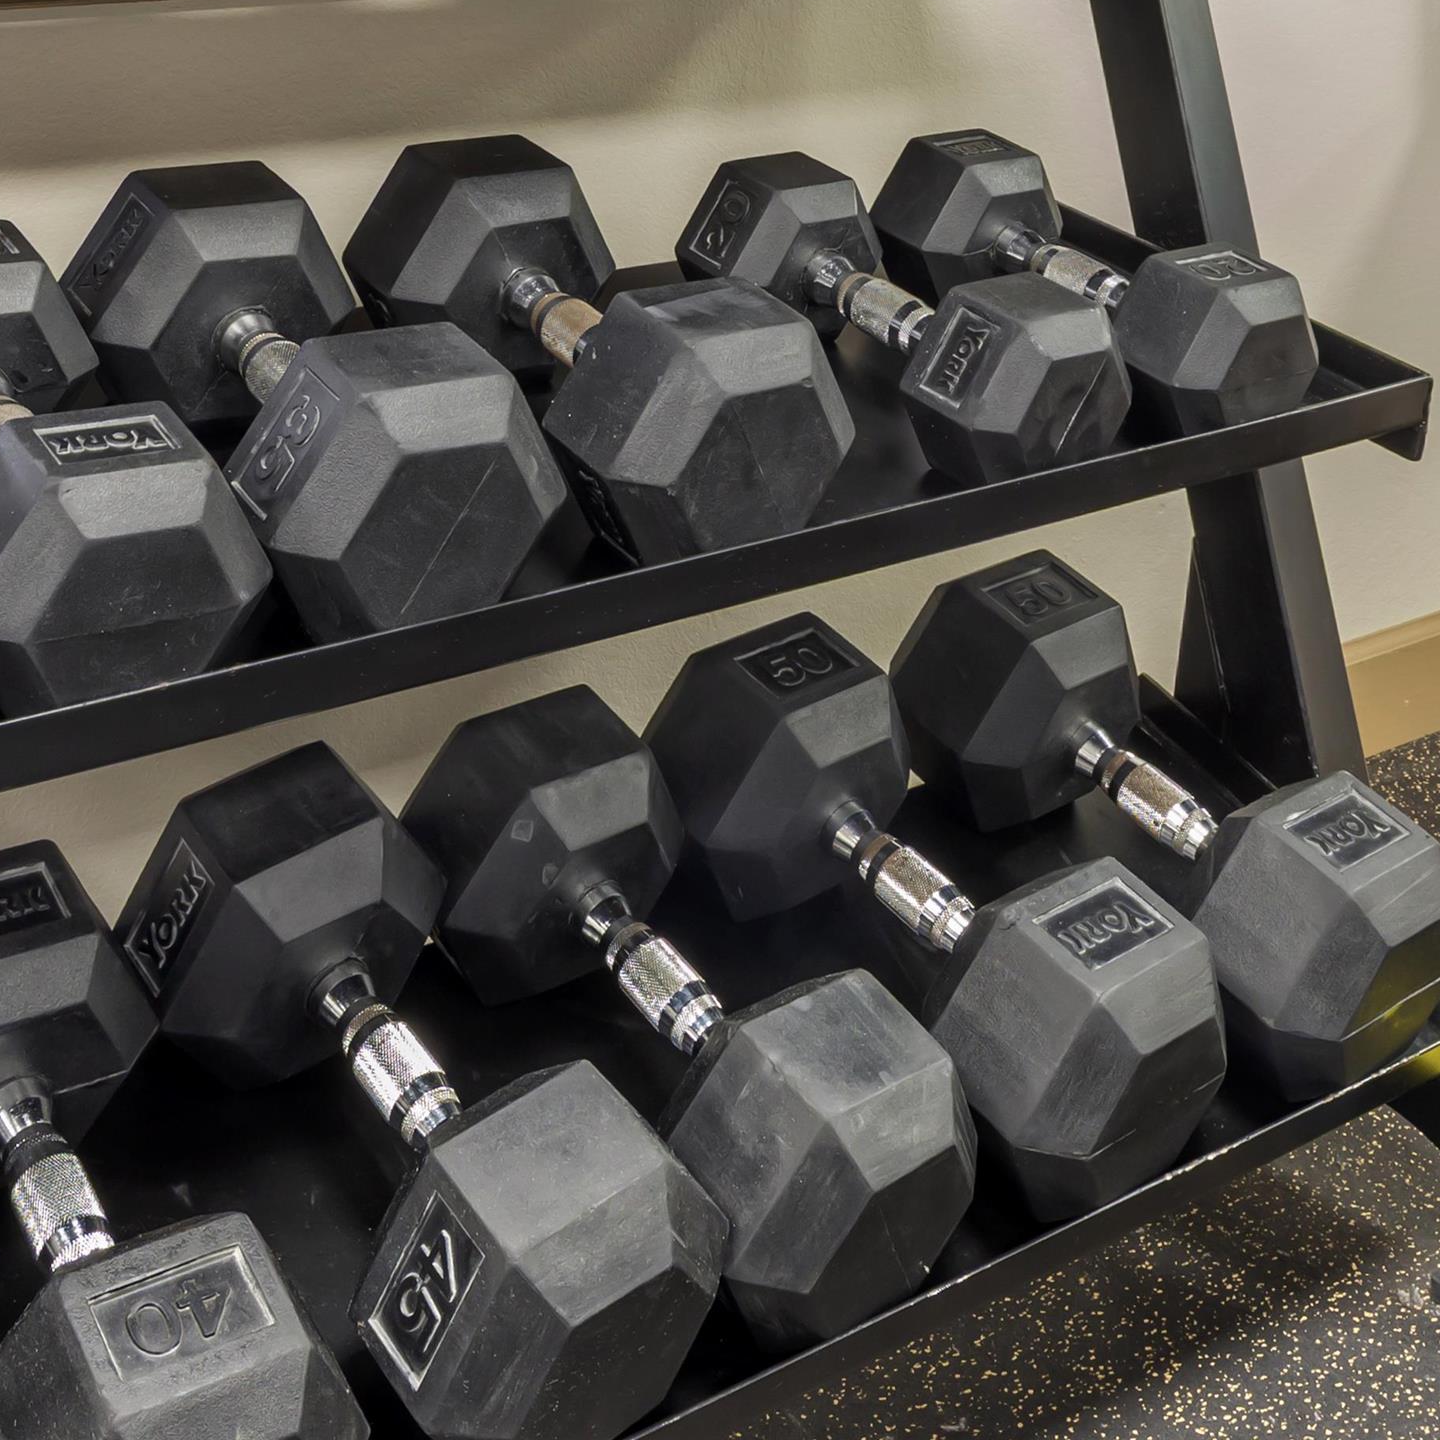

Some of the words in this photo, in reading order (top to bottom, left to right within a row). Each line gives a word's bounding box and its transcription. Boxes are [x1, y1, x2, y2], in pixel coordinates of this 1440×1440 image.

[78, 208, 144, 289] YORK
[704, 188, 752, 259] 20
[1188, 258, 1258, 280] 20
[937, 324, 991, 395] YORK
[48, 429, 168, 455] YORK
[255, 393, 321, 493] 35
[767, 645, 834, 688] 50
[1303, 808, 1392, 857] YORK
[138, 860, 206, 969] YORK
[1056, 901, 1156, 956] YORK
[124, 1277, 233, 1358] 40
[396, 1228, 457, 1354] 45
